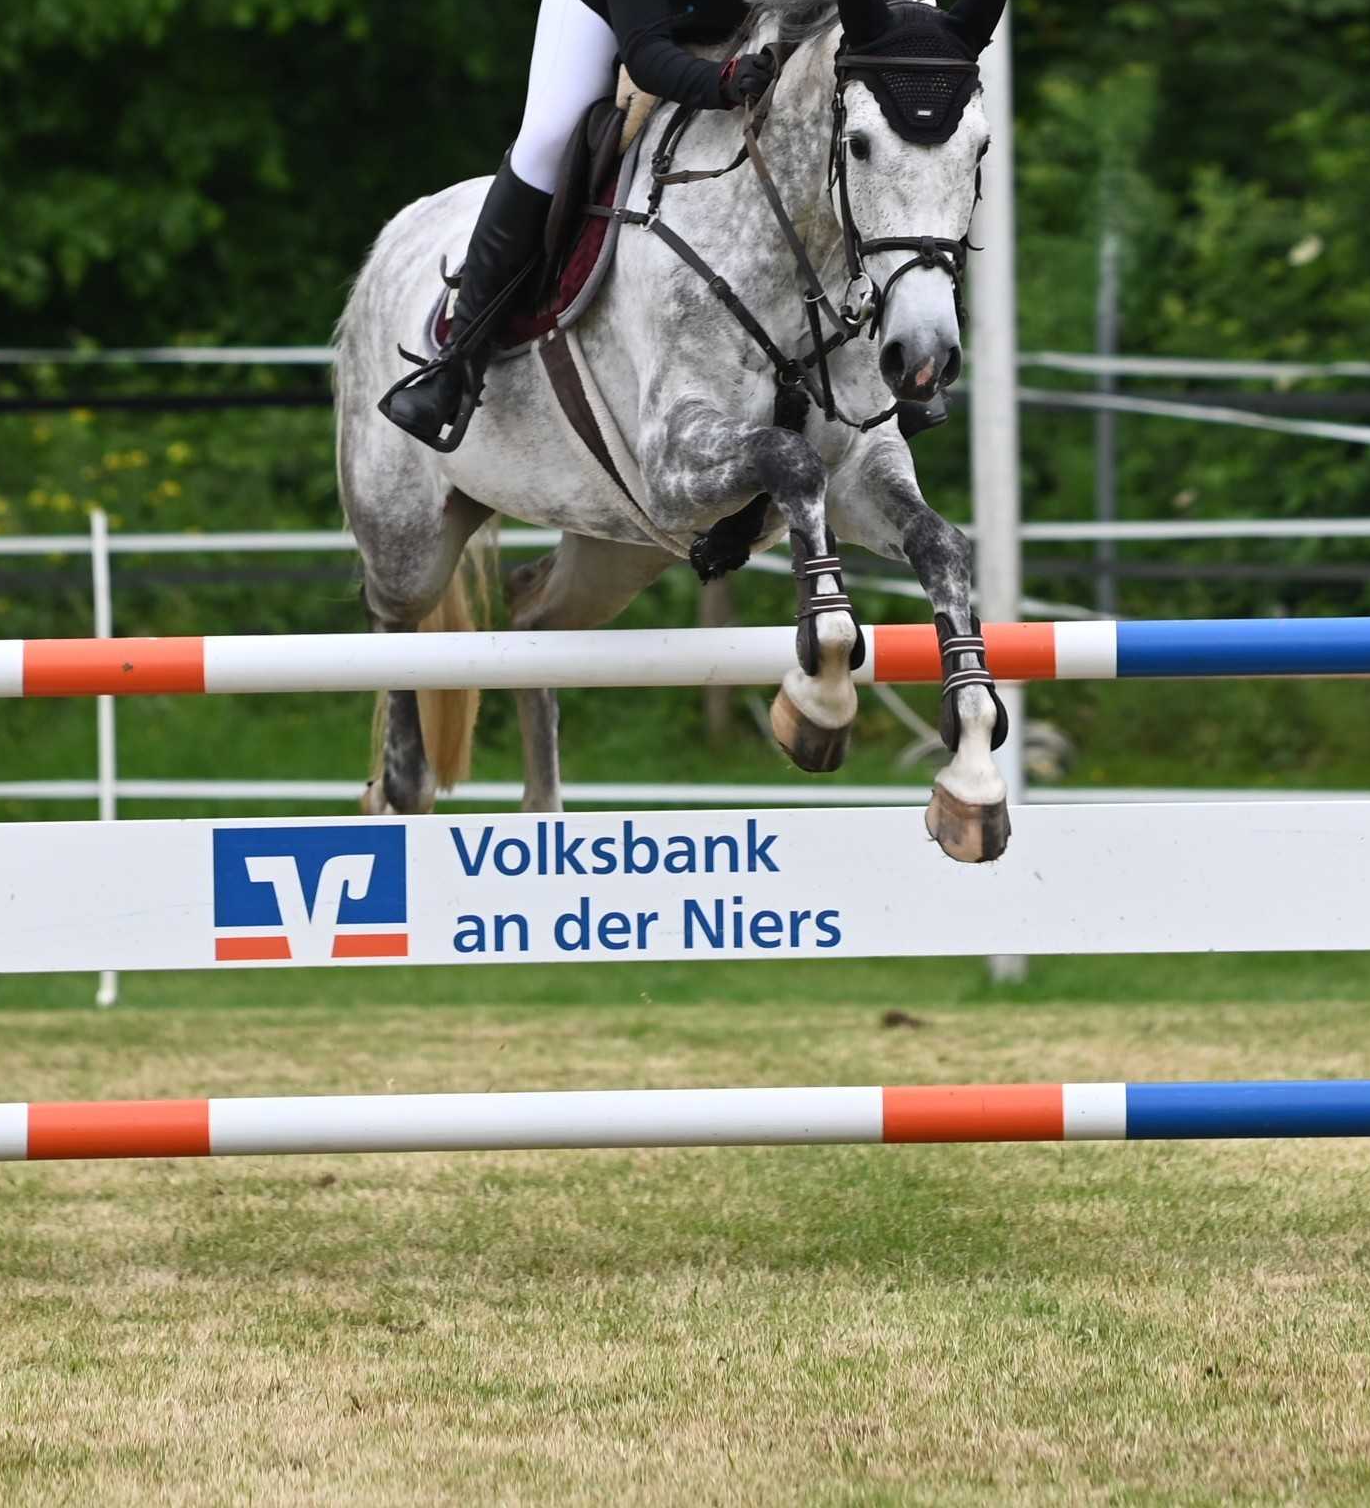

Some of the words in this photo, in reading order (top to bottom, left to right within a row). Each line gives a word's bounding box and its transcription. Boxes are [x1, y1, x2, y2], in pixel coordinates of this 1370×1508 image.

[449, 818, 781, 877] Volksbank
[452, 912, 530, 953] an
[553, 895, 660, 952] der
[682, 894, 843, 950] Niers
